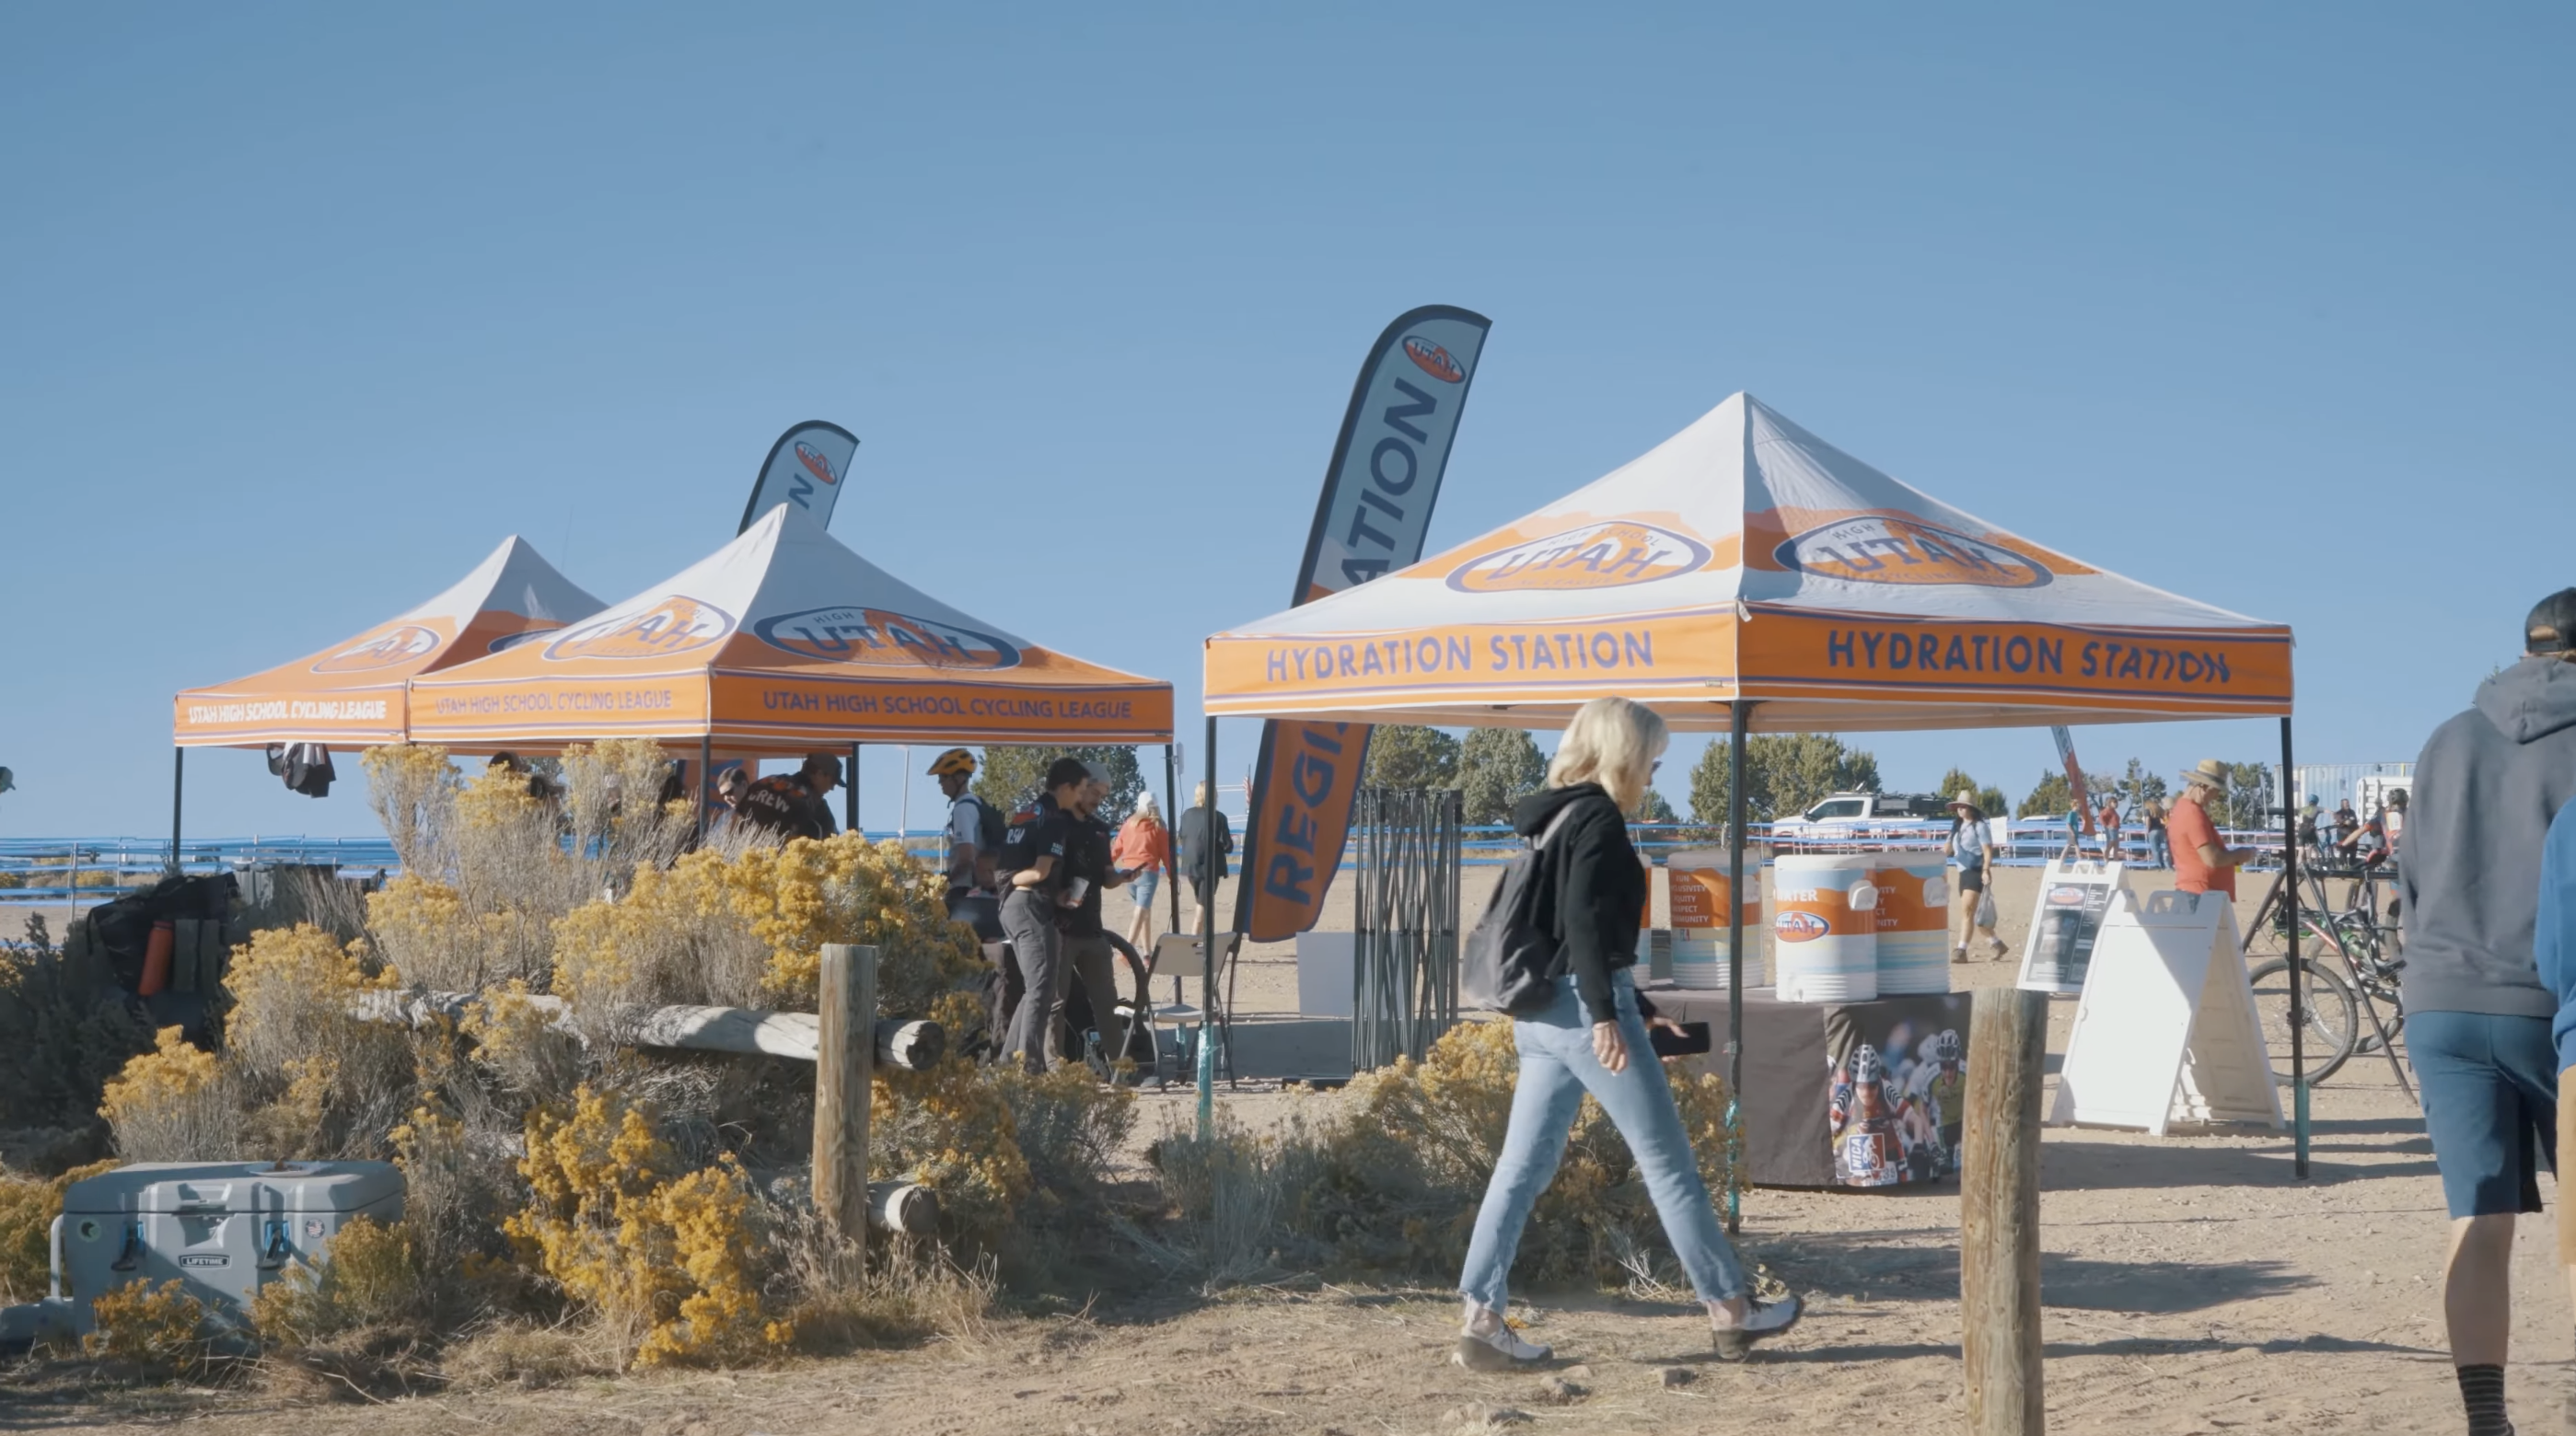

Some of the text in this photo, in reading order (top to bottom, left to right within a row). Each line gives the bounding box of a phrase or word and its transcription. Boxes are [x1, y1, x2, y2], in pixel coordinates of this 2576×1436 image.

[1599, 527, 1661, 547] SCHOOL
[1832, 523, 1875, 540] HIGH
[1485, 541, 1673, 579] UTAH
[1816, 537, 2016, 578] UTAH
[813, 611, 854, 624] HIGH
[794, 624, 981, 661] UTAH
[1266, 631, 1654, 681] HYDRATION STATION
[1827, 631, 2232, 684] HYDRATION STATION
[190, 701, 387, 724] UTAH HIGH SCHOOL CYCLING LEAGUE
[436, 689, 672, 714] UTAH HIGH SCHOOL CYCLING LEAGUE
[763, 691, 1132, 719] UTAH HIGH SCHOOL CYCLING LEAGUE
[1777, 921, 1816, 933] UTAH
[1851, 1138, 1862, 1168] NICA
